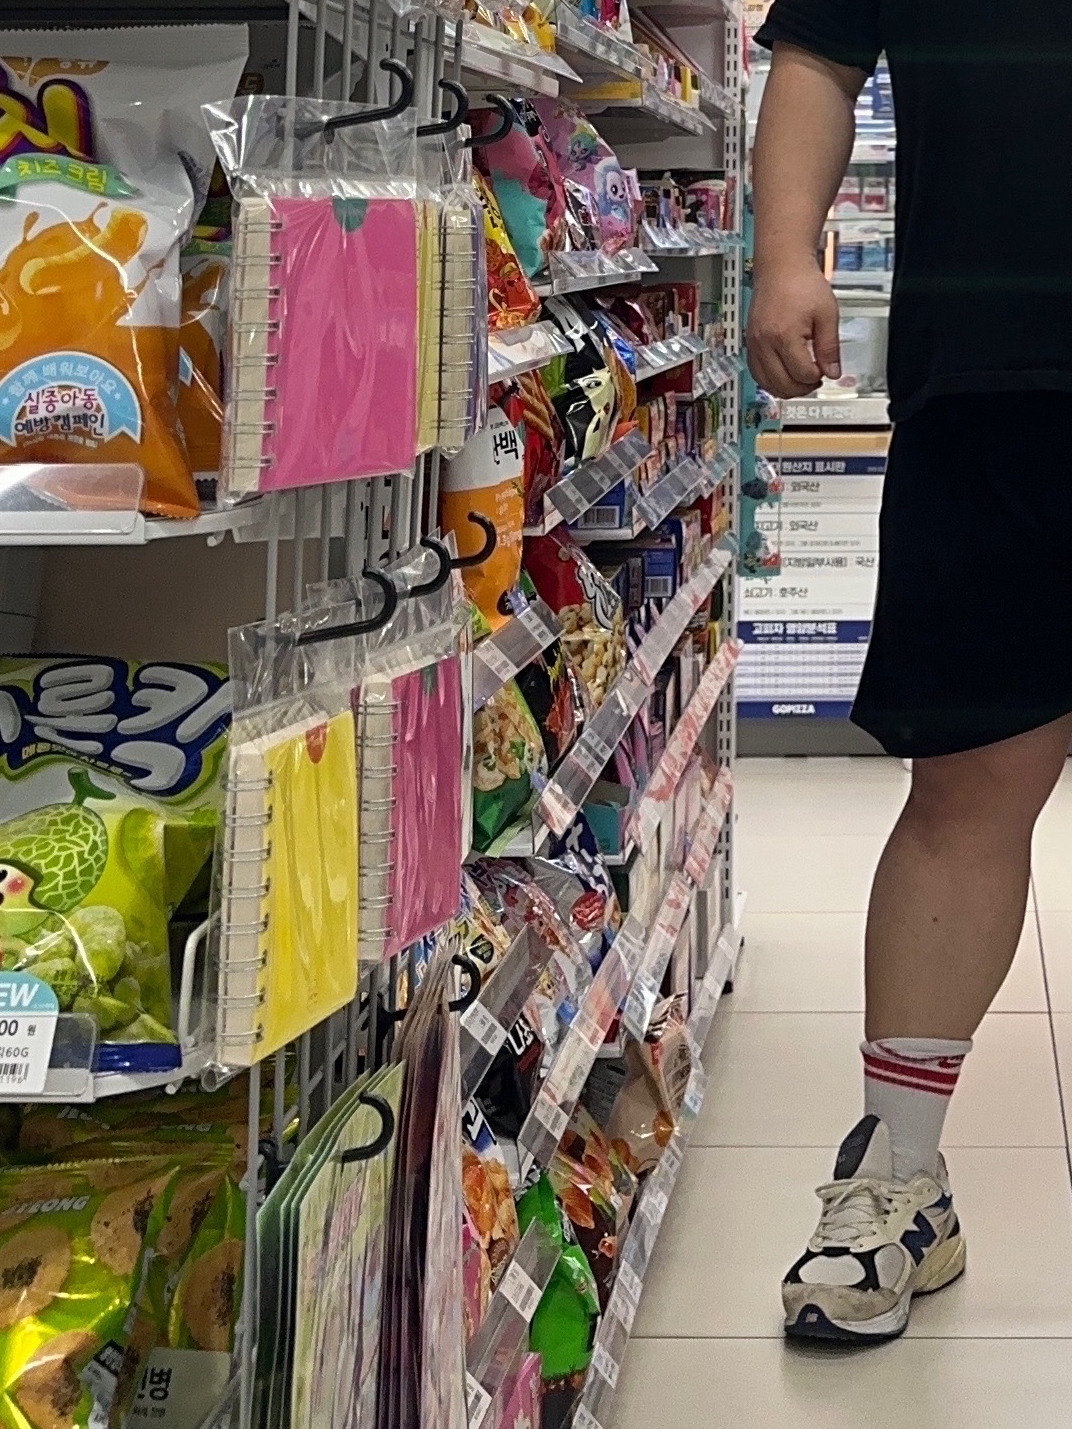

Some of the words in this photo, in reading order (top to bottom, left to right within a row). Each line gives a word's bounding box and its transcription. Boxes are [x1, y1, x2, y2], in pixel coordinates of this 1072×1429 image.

[17, 158, 62, 177] 치즈
[65, 162, 107, 193] 크림
[25, 388, 98, 415] 실종아동
[788, 521, 819, 532] 외국산
[855, 556, 875, 568] 국산
[772, 704, 816, 715] GOPIZZA
[0, 663, 239, 791] 론킥
[0, 983, 39, 1007] EW
